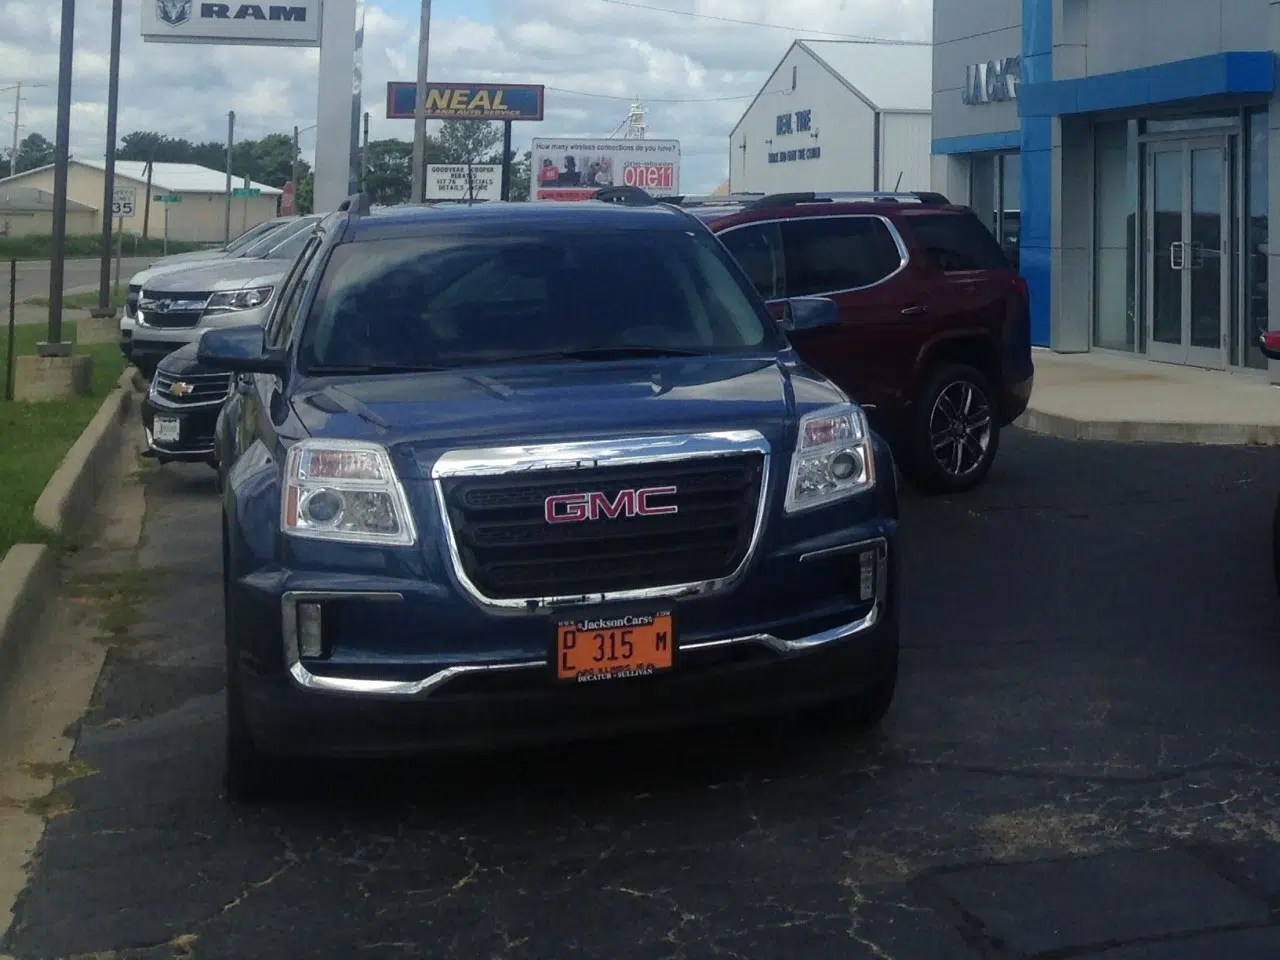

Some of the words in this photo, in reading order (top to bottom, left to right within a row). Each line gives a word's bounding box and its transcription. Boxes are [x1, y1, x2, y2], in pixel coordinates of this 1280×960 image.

[200, 2, 307, 22] RAM
[425, 89, 509, 110] NEAL
[624, 166, 673, 187] one11
[112, 202, 132, 214] 35
[545, 486, 678, 524] GMC
[582, 615, 649, 631] JacksonCars
[592, 630, 633, 662] 315
[655, 631, 667, 651] M
[577, 672, 612, 683] DECATUR
[617, 668, 654, 679] SULLIVAN
